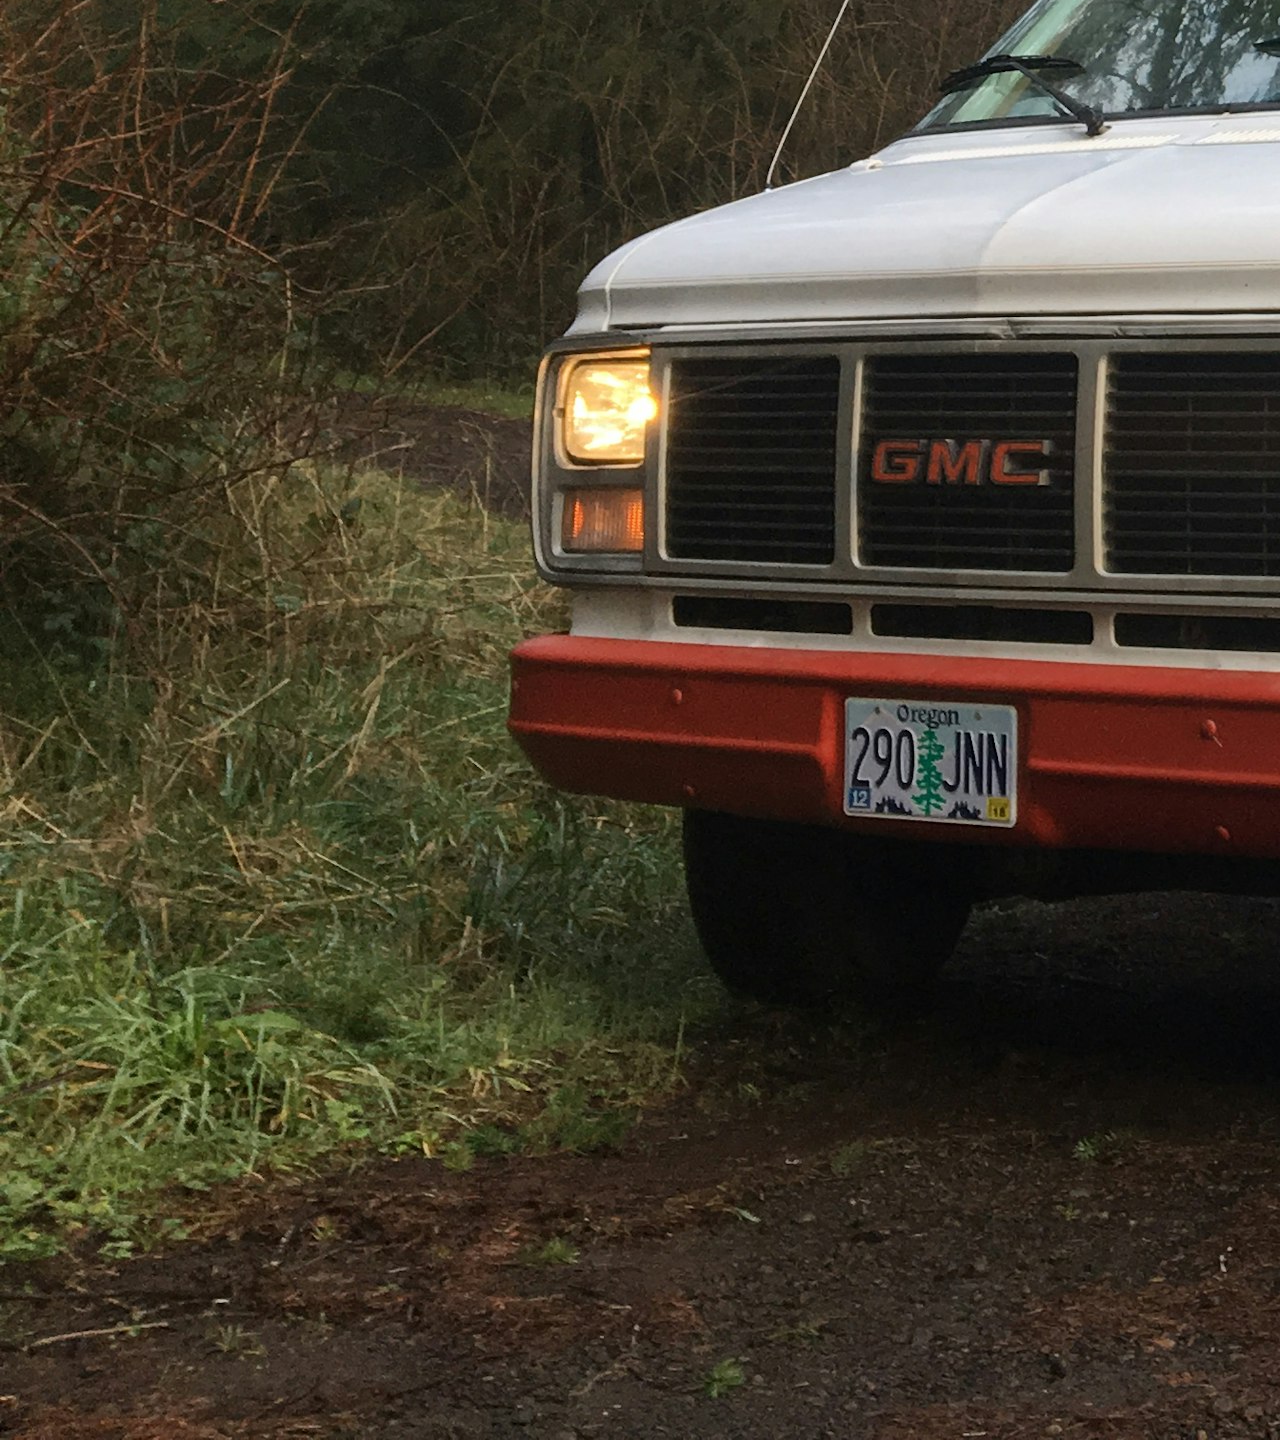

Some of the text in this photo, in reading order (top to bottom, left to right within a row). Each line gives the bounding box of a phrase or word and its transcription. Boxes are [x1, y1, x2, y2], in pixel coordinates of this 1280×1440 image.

[871, 438, 1050, 486] GMC
[897, 704, 961, 729] Oregon
[852, 727, 1008, 796] 290 JNN
[852, 790, 868, 807] 12
